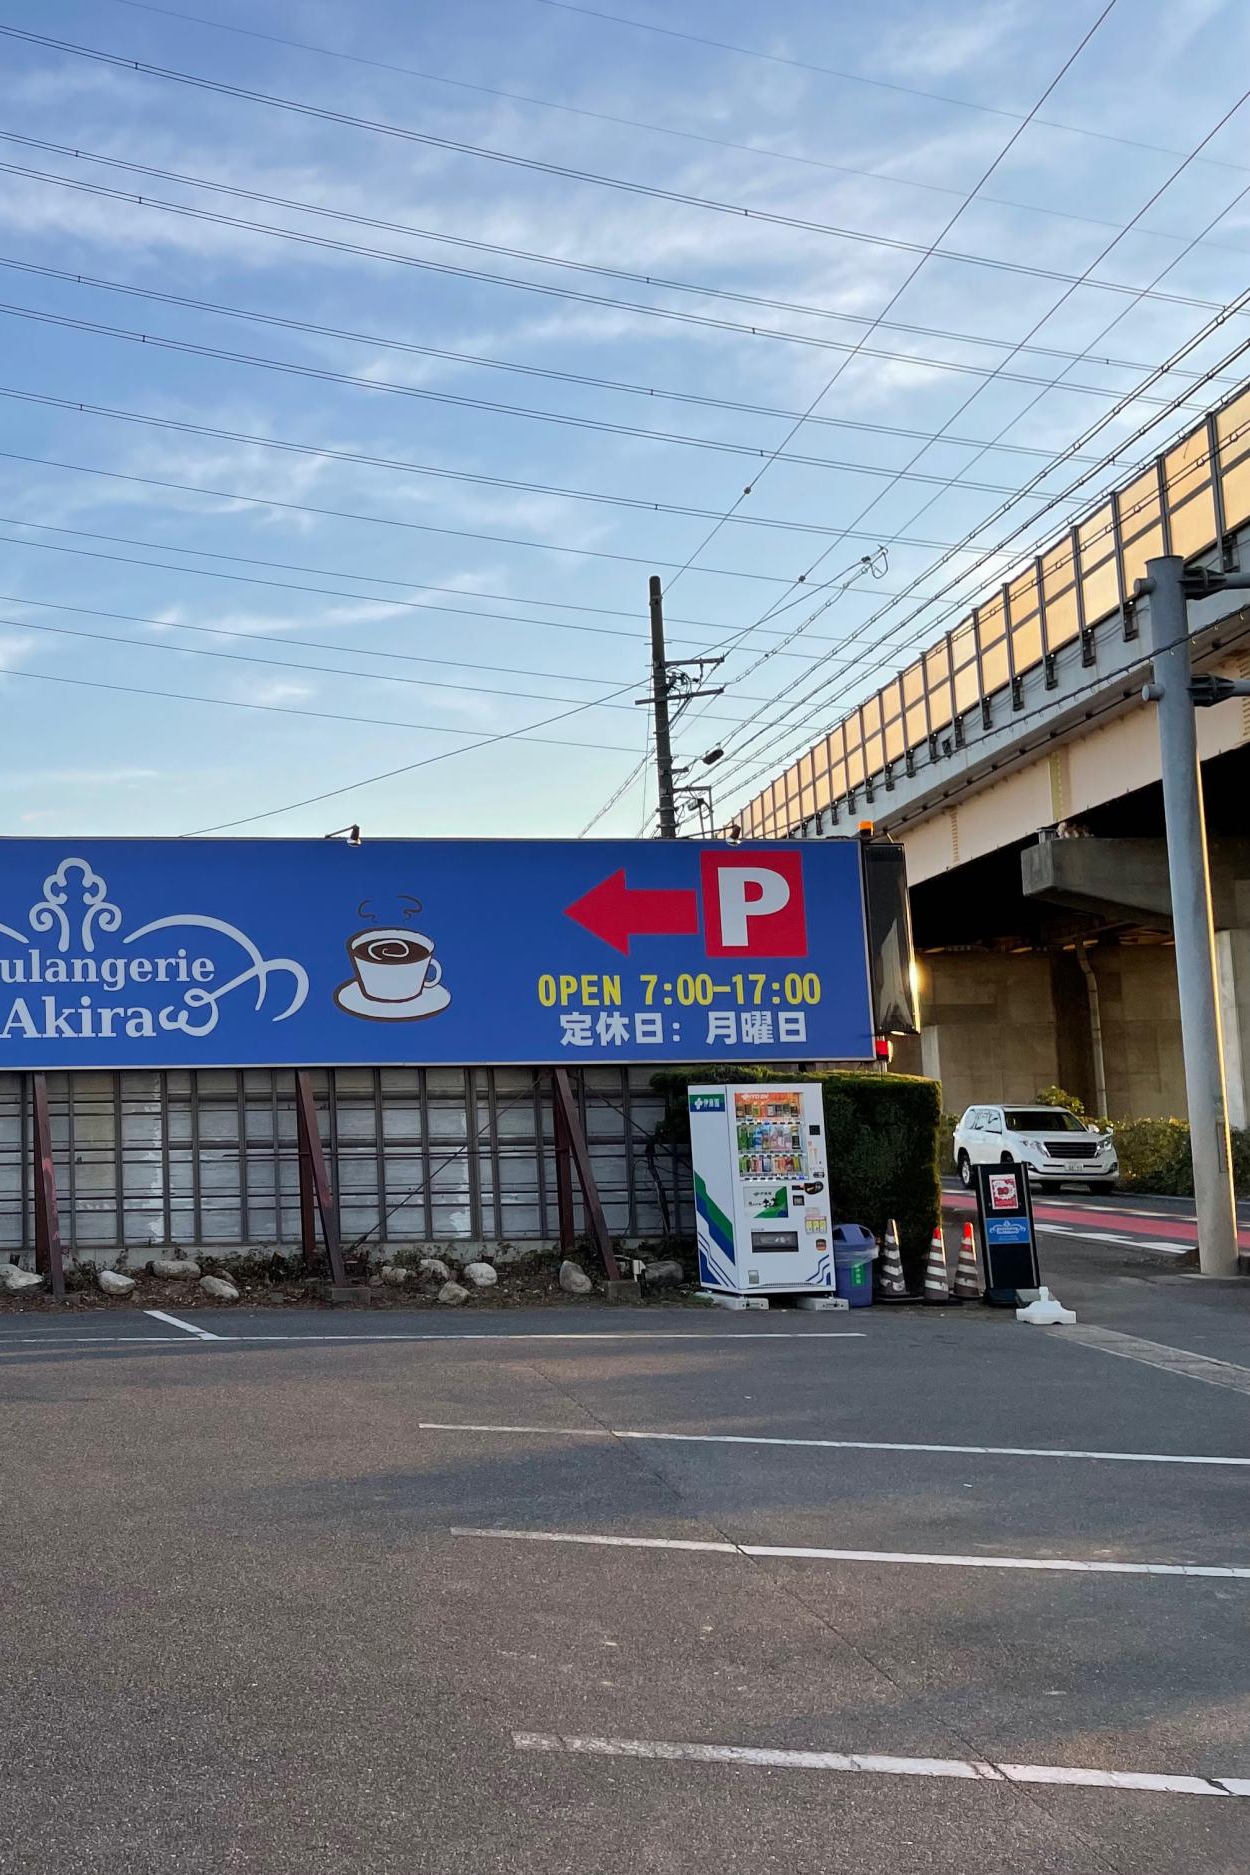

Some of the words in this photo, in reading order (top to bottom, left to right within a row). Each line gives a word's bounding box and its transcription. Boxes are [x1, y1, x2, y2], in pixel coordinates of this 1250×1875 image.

[717, 867, 791, 947] P
[538, 974, 622, 1007] OPEN
[639, 973, 821, 1006] 7:00-17:00
[0, 995, 157, 1039] Akira
[705, 1011, 807, 1046] 月曜日
